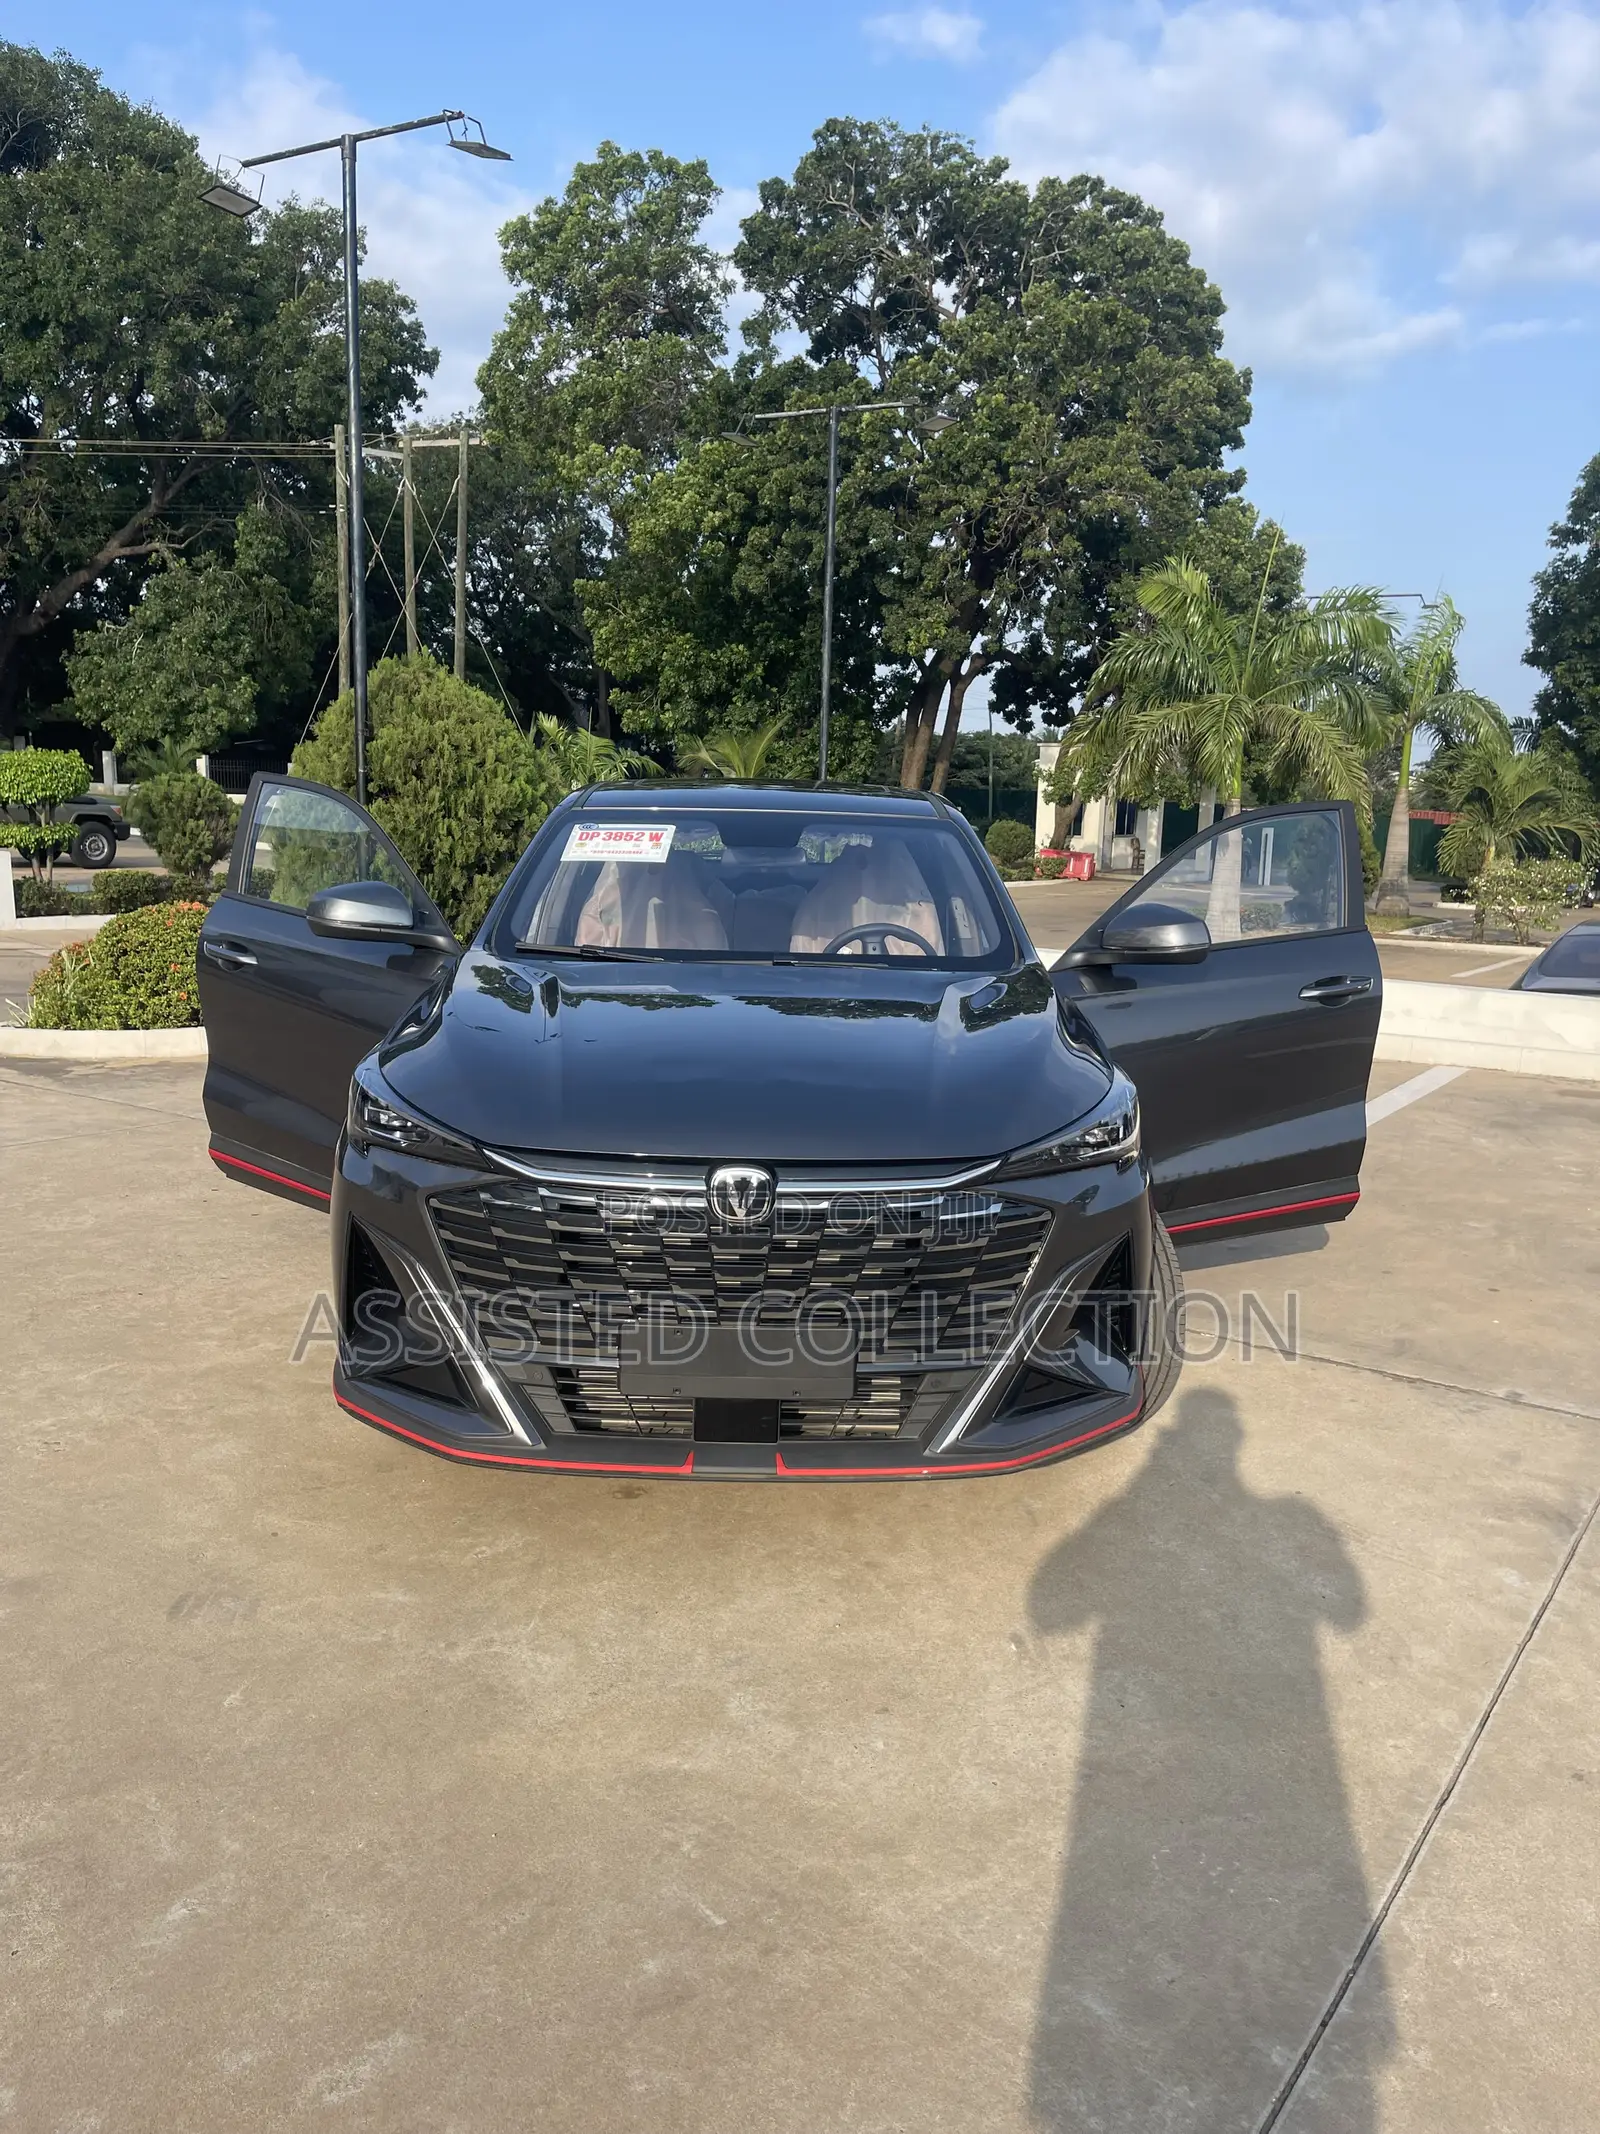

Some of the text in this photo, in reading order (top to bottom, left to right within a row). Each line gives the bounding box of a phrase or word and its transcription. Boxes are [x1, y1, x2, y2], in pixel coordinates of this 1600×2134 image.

[578, 831, 664, 842] DP 3852 W
